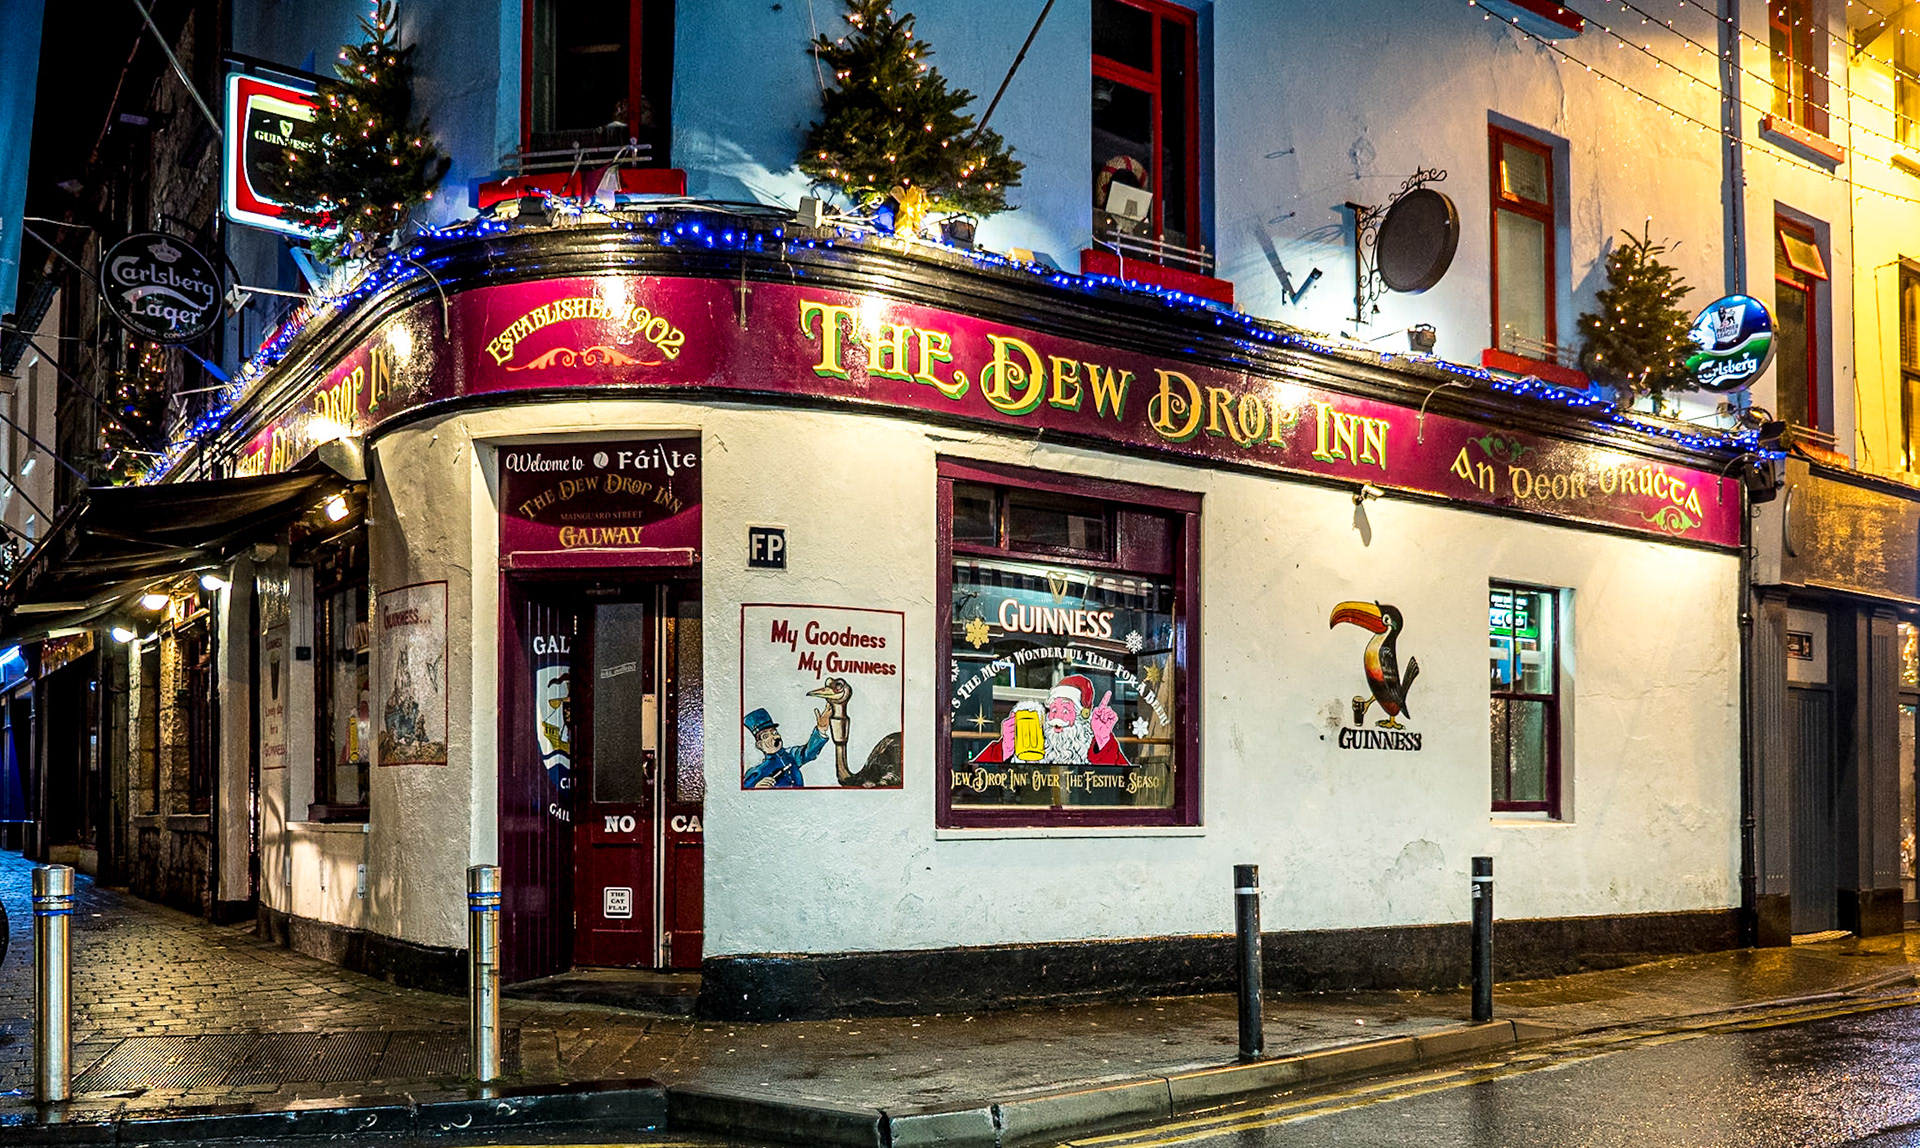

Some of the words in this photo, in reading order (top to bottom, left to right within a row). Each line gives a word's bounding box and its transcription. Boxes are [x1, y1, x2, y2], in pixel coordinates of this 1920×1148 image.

[111, 255, 214, 304] Carlsberg
[130, 299, 202, 331] Lager
[485, 297, 614, 366] ESTABLISHED
[618, 302, 686, 360] 1902
[800, 299, 969, 400] THE
[979, 333, 1136, 422] DEW
[1148, 368, 1297, 449] DROP
[1311, 399, 1391, 471] INN
[505, 453, 570, 473] Welcome
[571, 456, 585, 471] to
[519, 489, 556, 519] THE
[558, 475, 599, 501] DEW
[603, 473, 653, 497] DROP
[653, 486, 683, 515] INN
[560, 512, 612, 521] MAINGUARD
[612, 510, 644, 519] STREET
[559, 526, 644, 548] GALWAY
[997, 599, 1114, 638] GUINNESS
[771, 620, 798, 652] My
[805, 621, 886, 648] Goodness
[798, 651, 822, 680] My
[957, 675, 981, 700] THE
[980, 656, 1012, 682] MOST
[1013, 647, 1083, 666] WONDERFUL
[1085, 651, 1114, 670] TIME
[1115, 663, 1138, 688] FOR
[1136, 681, 1147, 697] A
[1338, 727, 1422, 751] GUINNESS
[973, 767, 1007, 793] DROP
[1007, 768, 1028, 793] INN
[1032, 770, 1060, 791] OVER
[1063, 770, 1083, 793] THE
[1083, 770, 1125, 794] FESTIVE
[604, 815, 636, 833] NO
